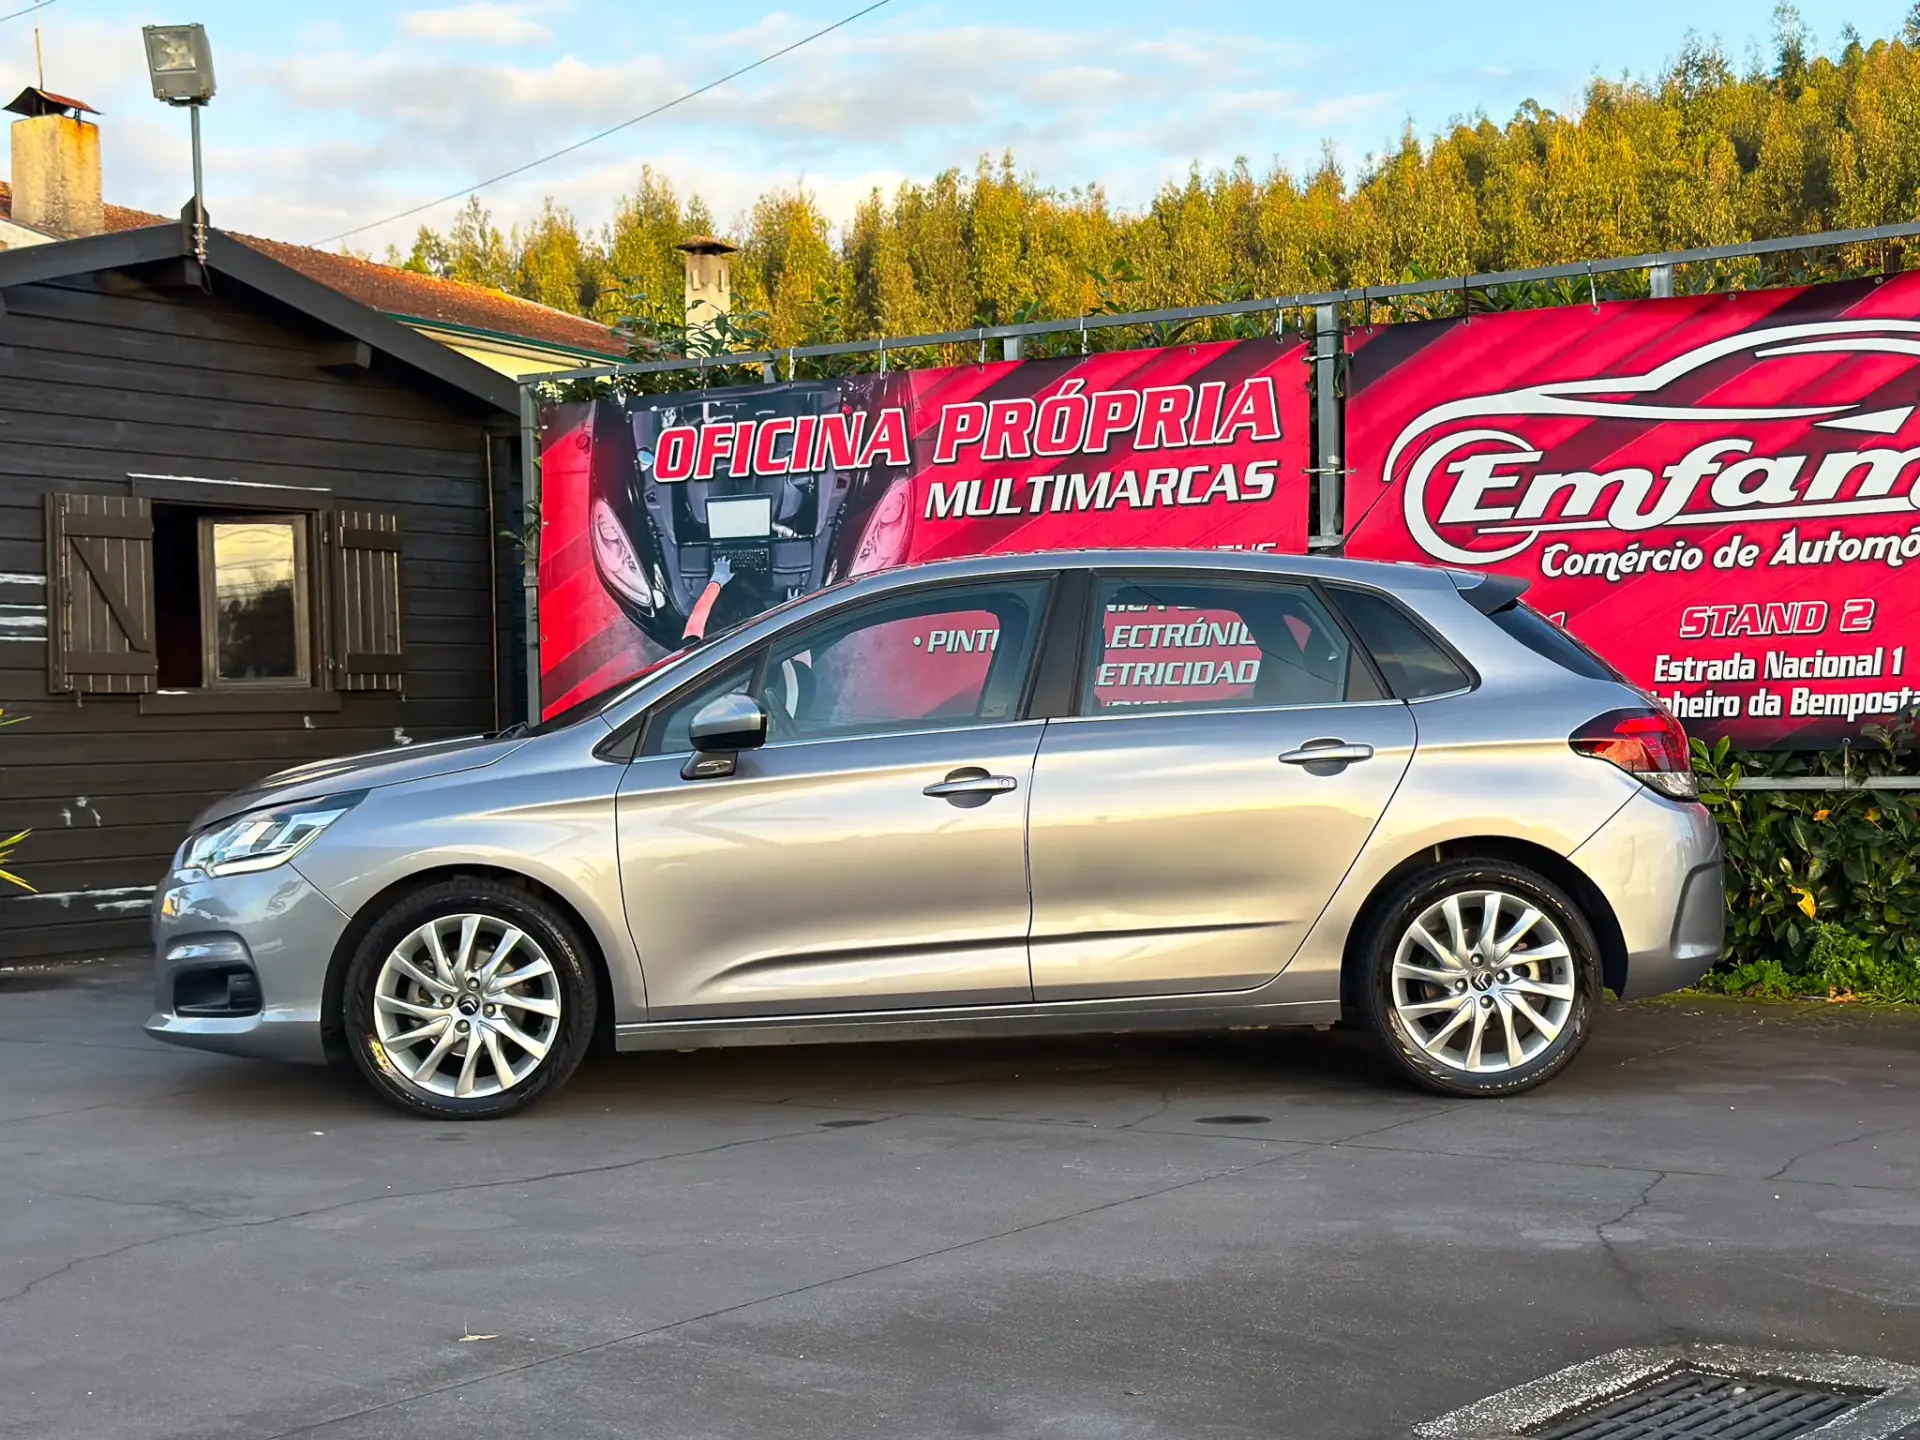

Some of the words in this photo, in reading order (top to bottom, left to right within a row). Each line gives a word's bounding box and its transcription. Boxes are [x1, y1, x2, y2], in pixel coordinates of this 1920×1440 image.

[653, 408, 911, 482] OFICINA
[932, 377, 1282, 463] PRÓPRIA
[924, 460, 1278, 518] MULTIMARCAS
[1541, 540, 1703, 582] Comércio
[1712, 534, 1761, 569] de
[1680, 600, 1830, 639] STAND
[1839, 598, 1876, 632] 2
[1095, 659, 1262, 687] ETRICIDAD
[1654, 652, 1757, 683] Estrada
[1763, 646, 1885, 680] Nacional
[1891, 645, 1905, 676] 1
[1747, 687, 1783, 717] da
